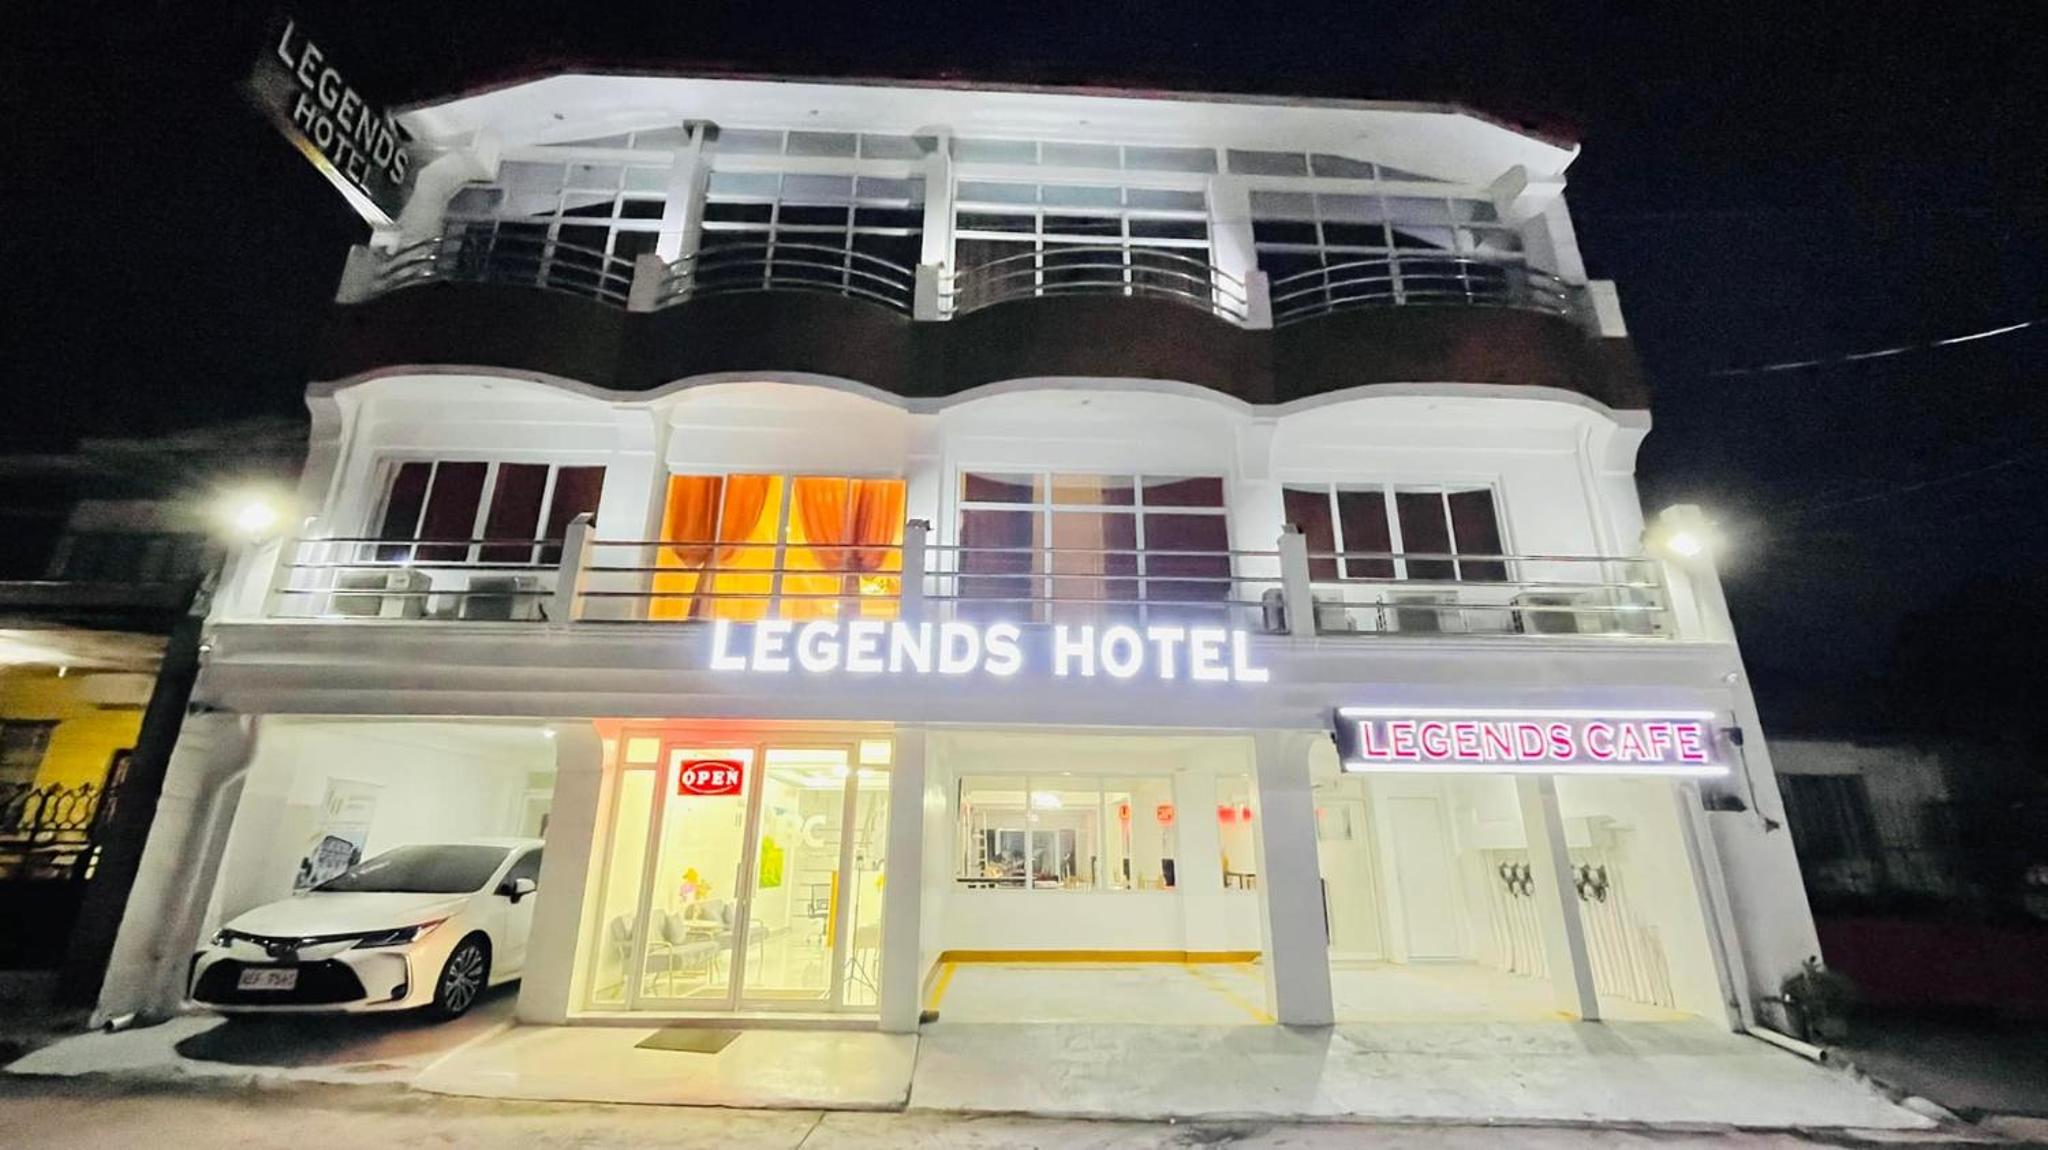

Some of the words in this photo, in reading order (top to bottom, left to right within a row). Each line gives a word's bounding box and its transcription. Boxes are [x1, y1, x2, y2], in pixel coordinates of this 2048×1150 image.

[278, 20, 408, 184] LEGENDS
[293, 93, 372, 196] HOTEL
[710, 620, 1021, 676] LEGENDS
[1053, 625, 1270, 682] HOTEL
[1359, 720, 1576, 760] LEGENDS
[1582, 721, 1709, 762] CAFE
[681, 770, 739, 786] OPEN
